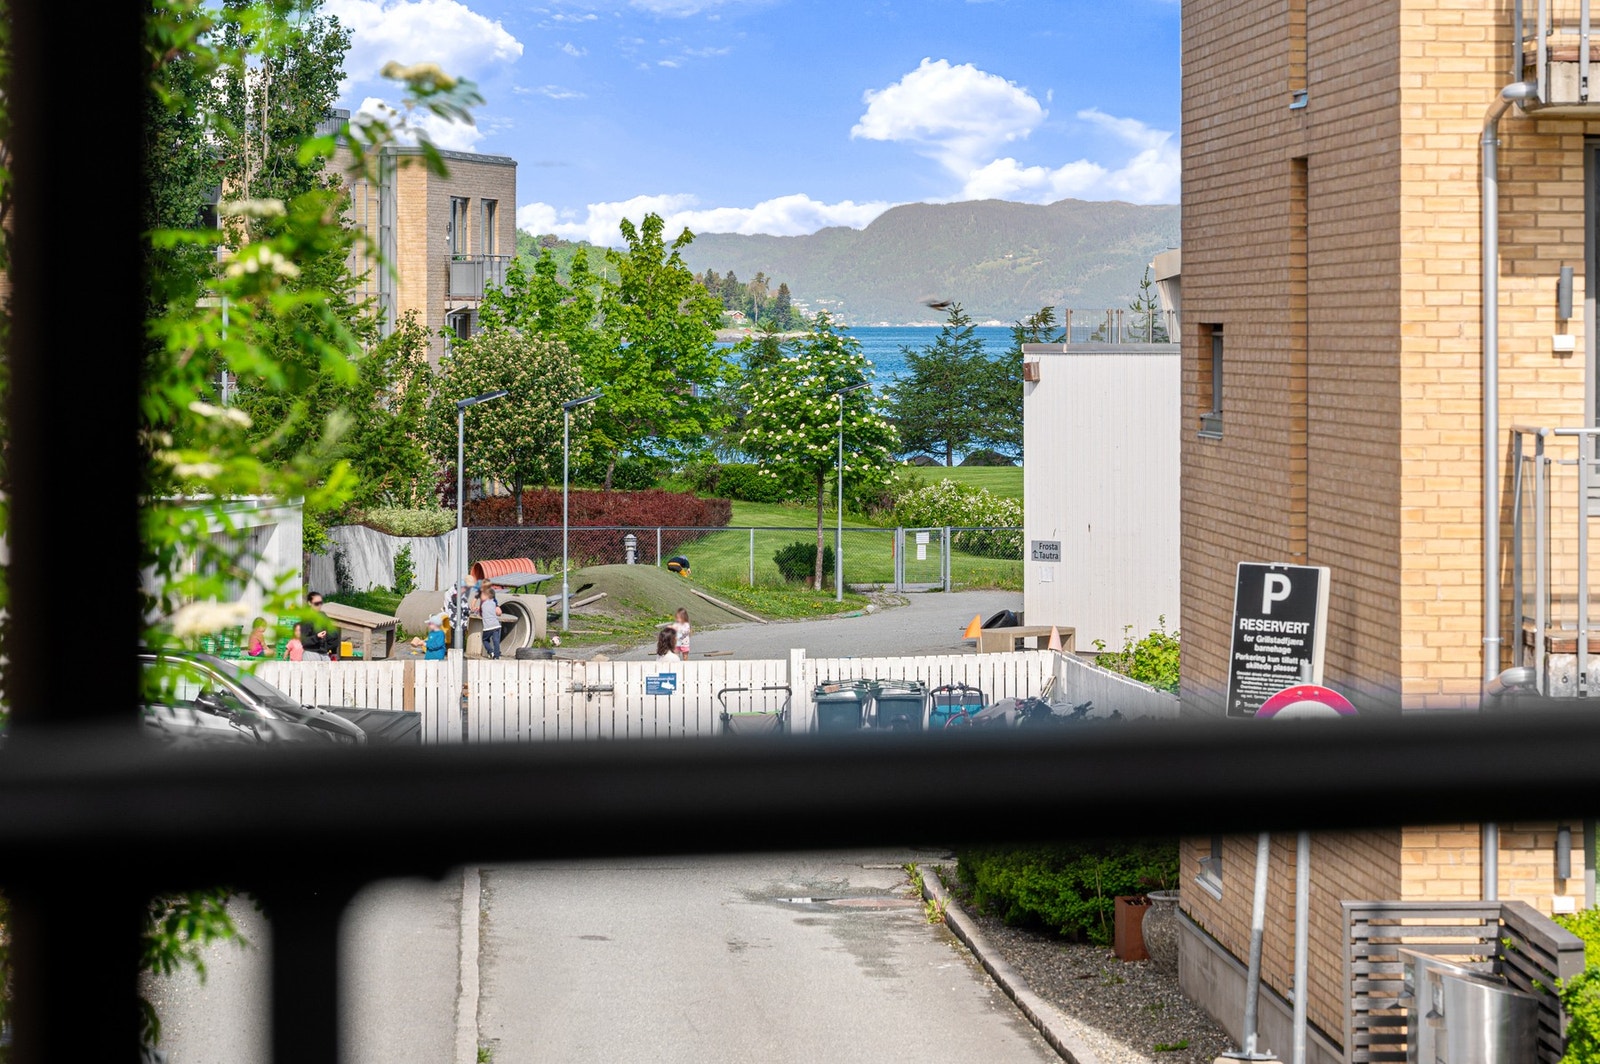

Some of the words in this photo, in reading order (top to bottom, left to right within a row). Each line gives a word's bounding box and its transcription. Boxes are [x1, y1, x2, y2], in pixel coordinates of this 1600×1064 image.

[1039, 542, 1058, 551] Frosta
[1039, 551, 1059, 560] Tautra
[1261, 573, 1292, 614] P
[1239, 618, 1310, 634] RESERVERT
[1243, 634, 1254, 642] for
[1254, 643, 1292, 655] barnehage
[1235, 652, 1266, 663] Parkering
[1267, 655, 1280, 663] kun
[1273, 664, 1297, 672] plasser
